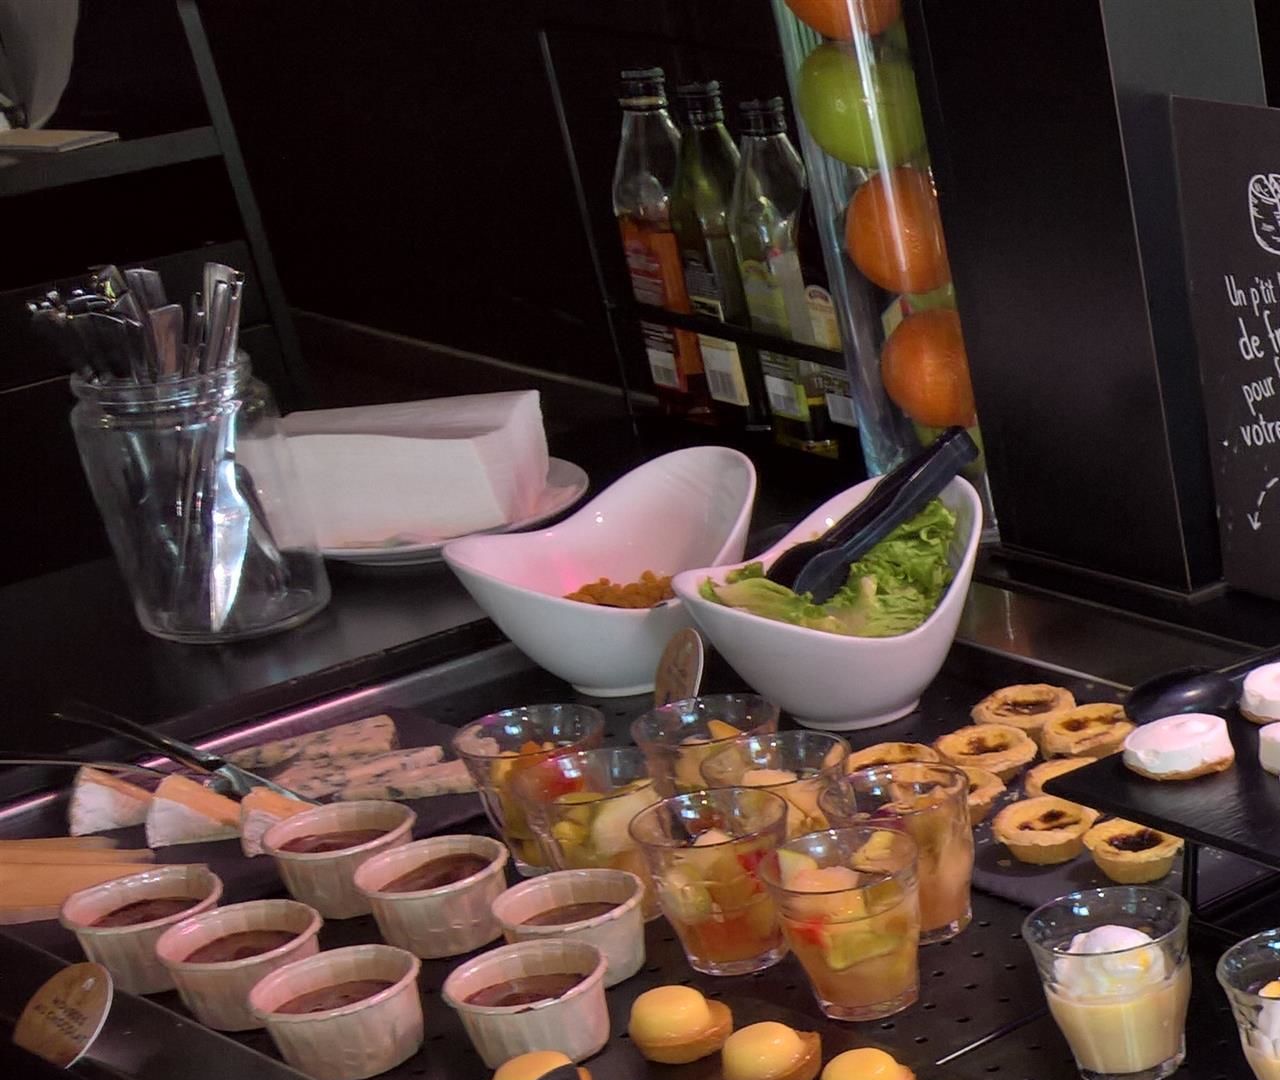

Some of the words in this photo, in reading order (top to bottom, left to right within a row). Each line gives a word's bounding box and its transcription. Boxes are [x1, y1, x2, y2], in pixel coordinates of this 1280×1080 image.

[1225, 275, 1247, 306] Un
[1239, 317, 1264, 360] de
[1242, 376, 1275, 416] pour
